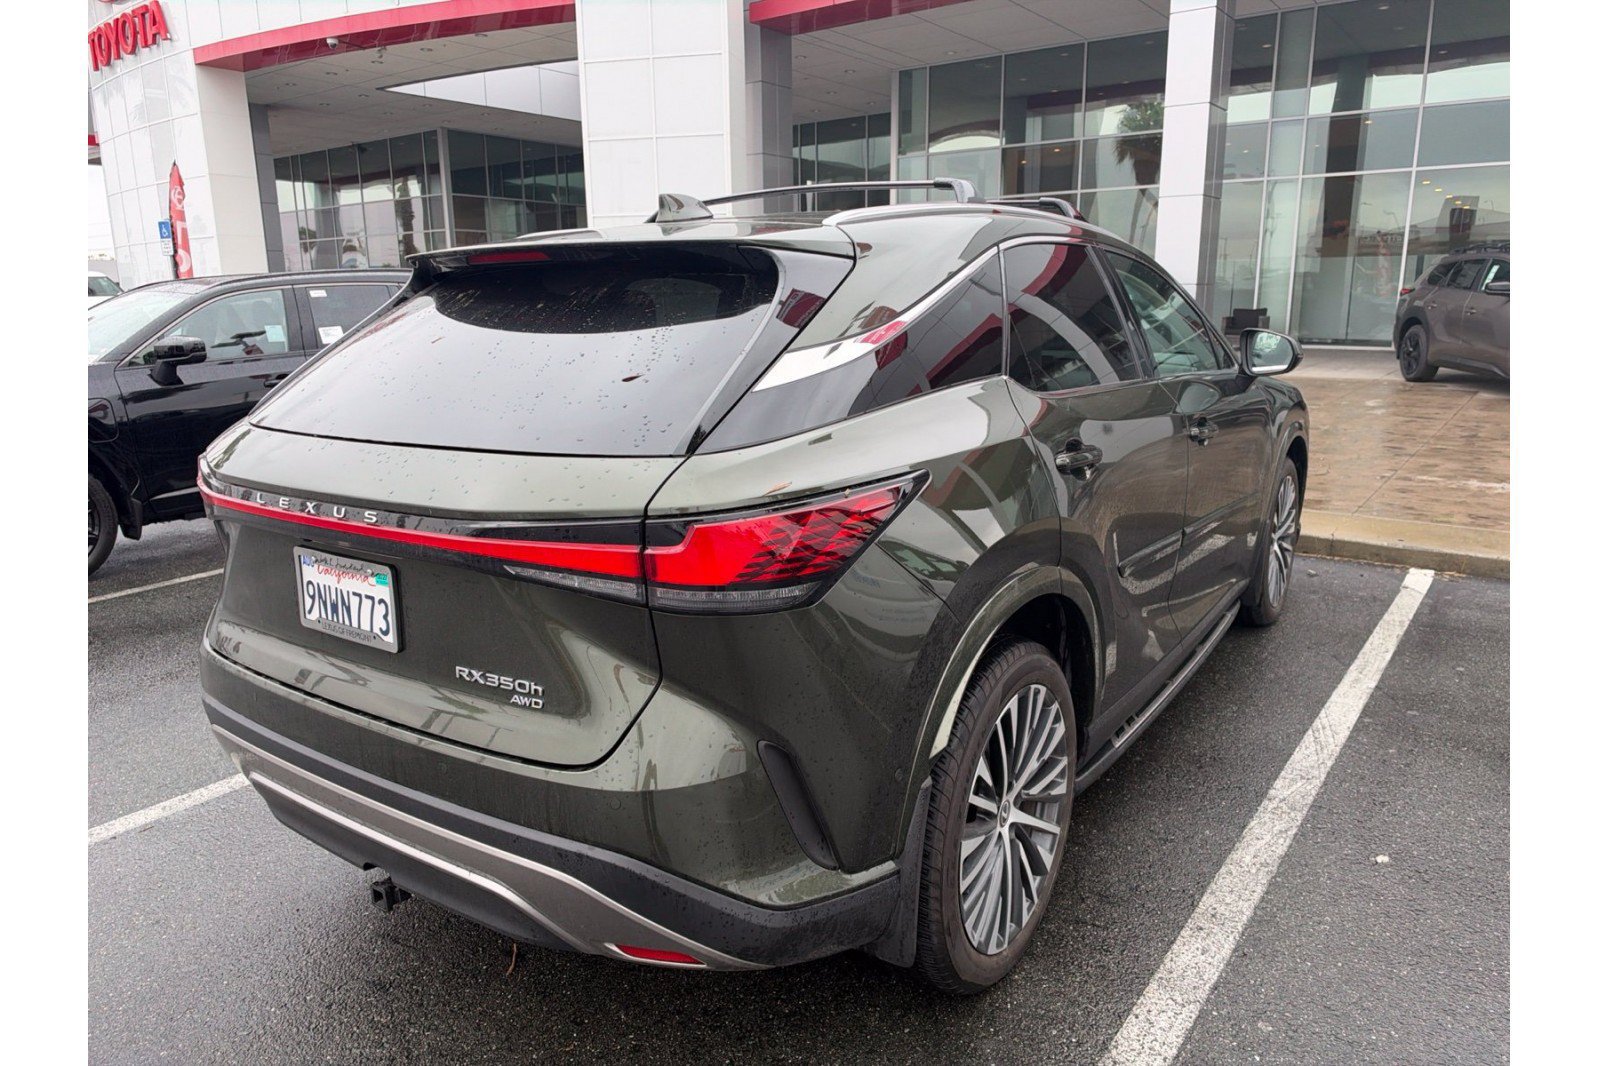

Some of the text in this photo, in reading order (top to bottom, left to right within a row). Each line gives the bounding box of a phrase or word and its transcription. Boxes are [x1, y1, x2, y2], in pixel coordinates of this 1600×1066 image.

[88, 0, 171, 71] TOYOTA
[256, 492, 378, 523] LEXUS
[306, 580, 390, 637] 9NWN773
[455, 666, 543, 696] RX350h
[510, 694, 543, 709] AWD
